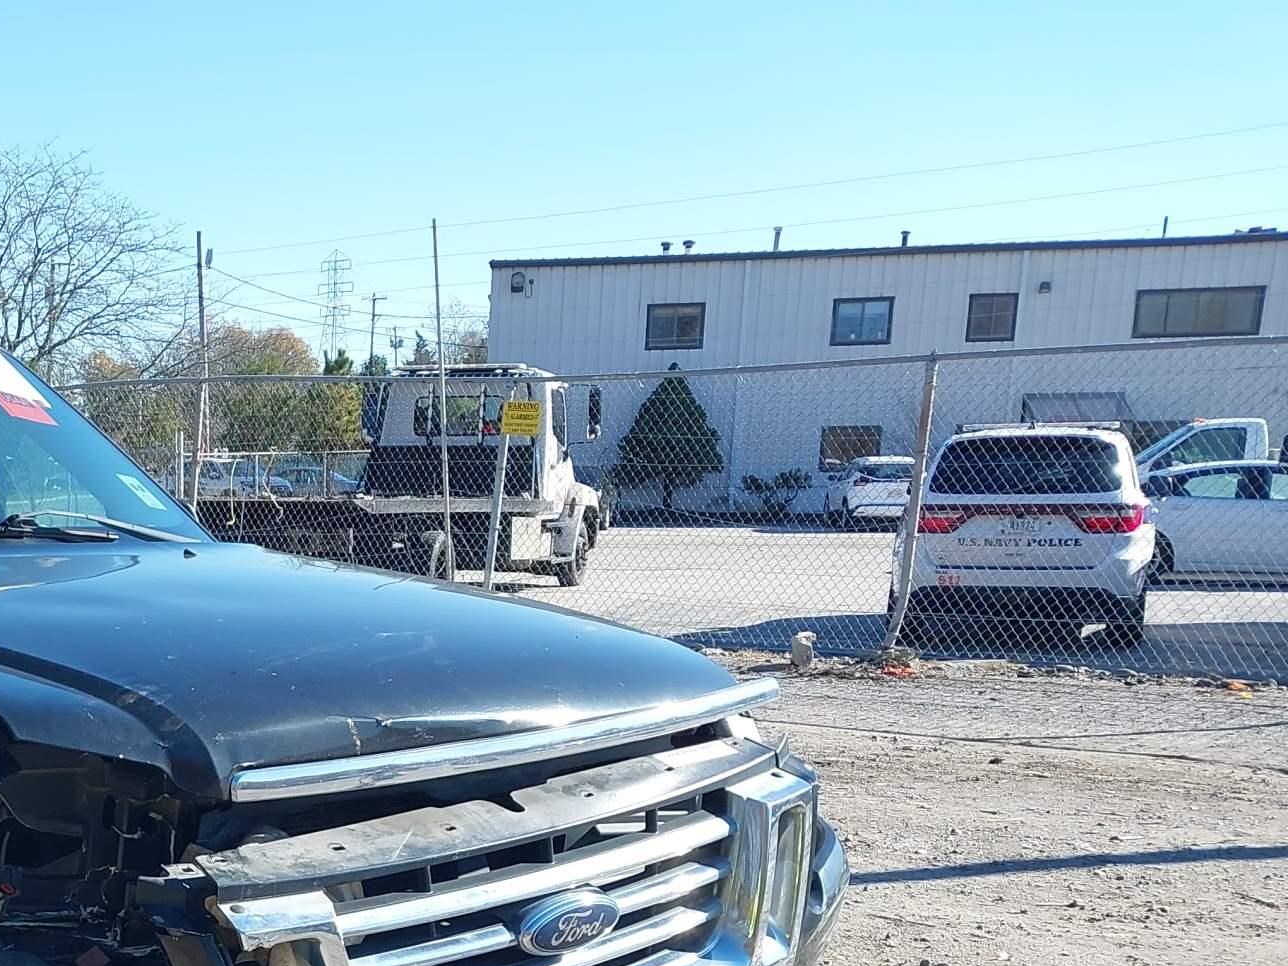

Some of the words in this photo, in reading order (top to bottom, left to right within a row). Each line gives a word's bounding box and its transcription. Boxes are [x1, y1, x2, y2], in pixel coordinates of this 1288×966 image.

[507, 402, 539, 411] WARNING
[957, 537, 981, 547] U.S.
[983, 537, 1022, 547] NAVY
[1026, 537, 1083, 547] POLICE
[938, 574, 960, 585] 911
[551, 908, 605, 946] Ford
